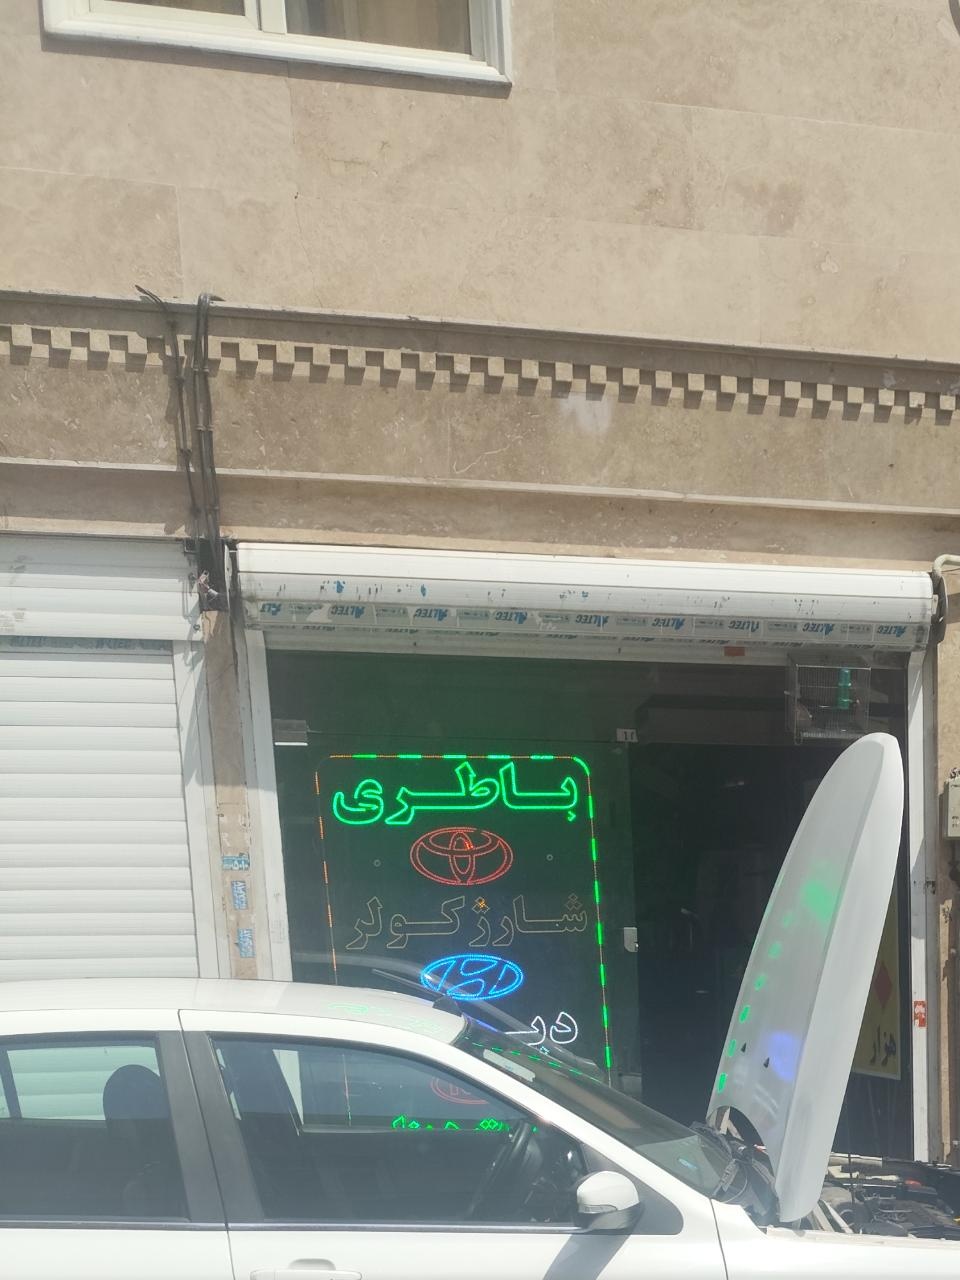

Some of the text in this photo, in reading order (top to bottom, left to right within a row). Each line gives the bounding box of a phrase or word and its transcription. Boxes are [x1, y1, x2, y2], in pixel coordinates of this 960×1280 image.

[330, 604, 365, 619] ALTEC
[413, 608, 449, 622] ALTEC
[652, 617, 686, 630] ALTEC
[877, 624, 908, 638] ALTEC
[332, 761, 579, 825] باطری
[345, 892, 588, 951] شارژ کولر
